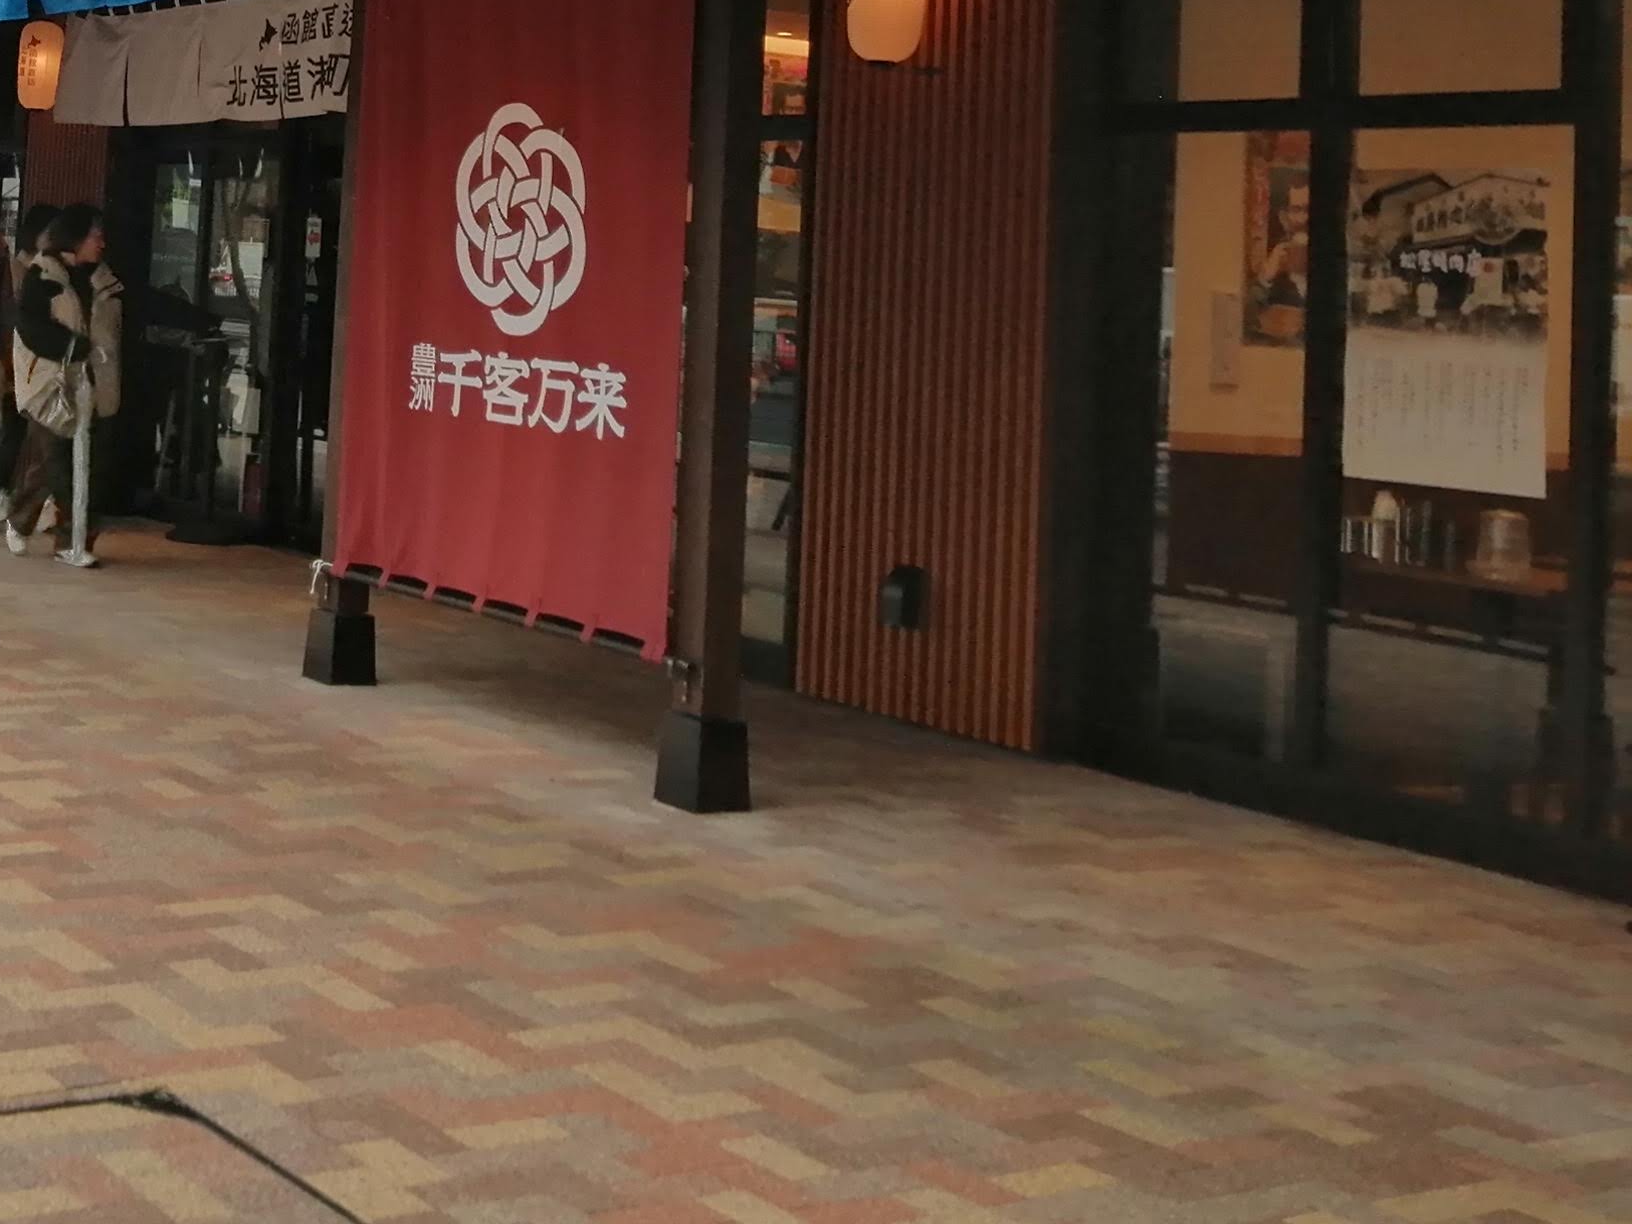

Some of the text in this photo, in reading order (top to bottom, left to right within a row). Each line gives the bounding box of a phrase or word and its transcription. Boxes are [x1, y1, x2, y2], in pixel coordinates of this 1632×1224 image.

[409, 342, 627, 440] 豊洲 千客万来
